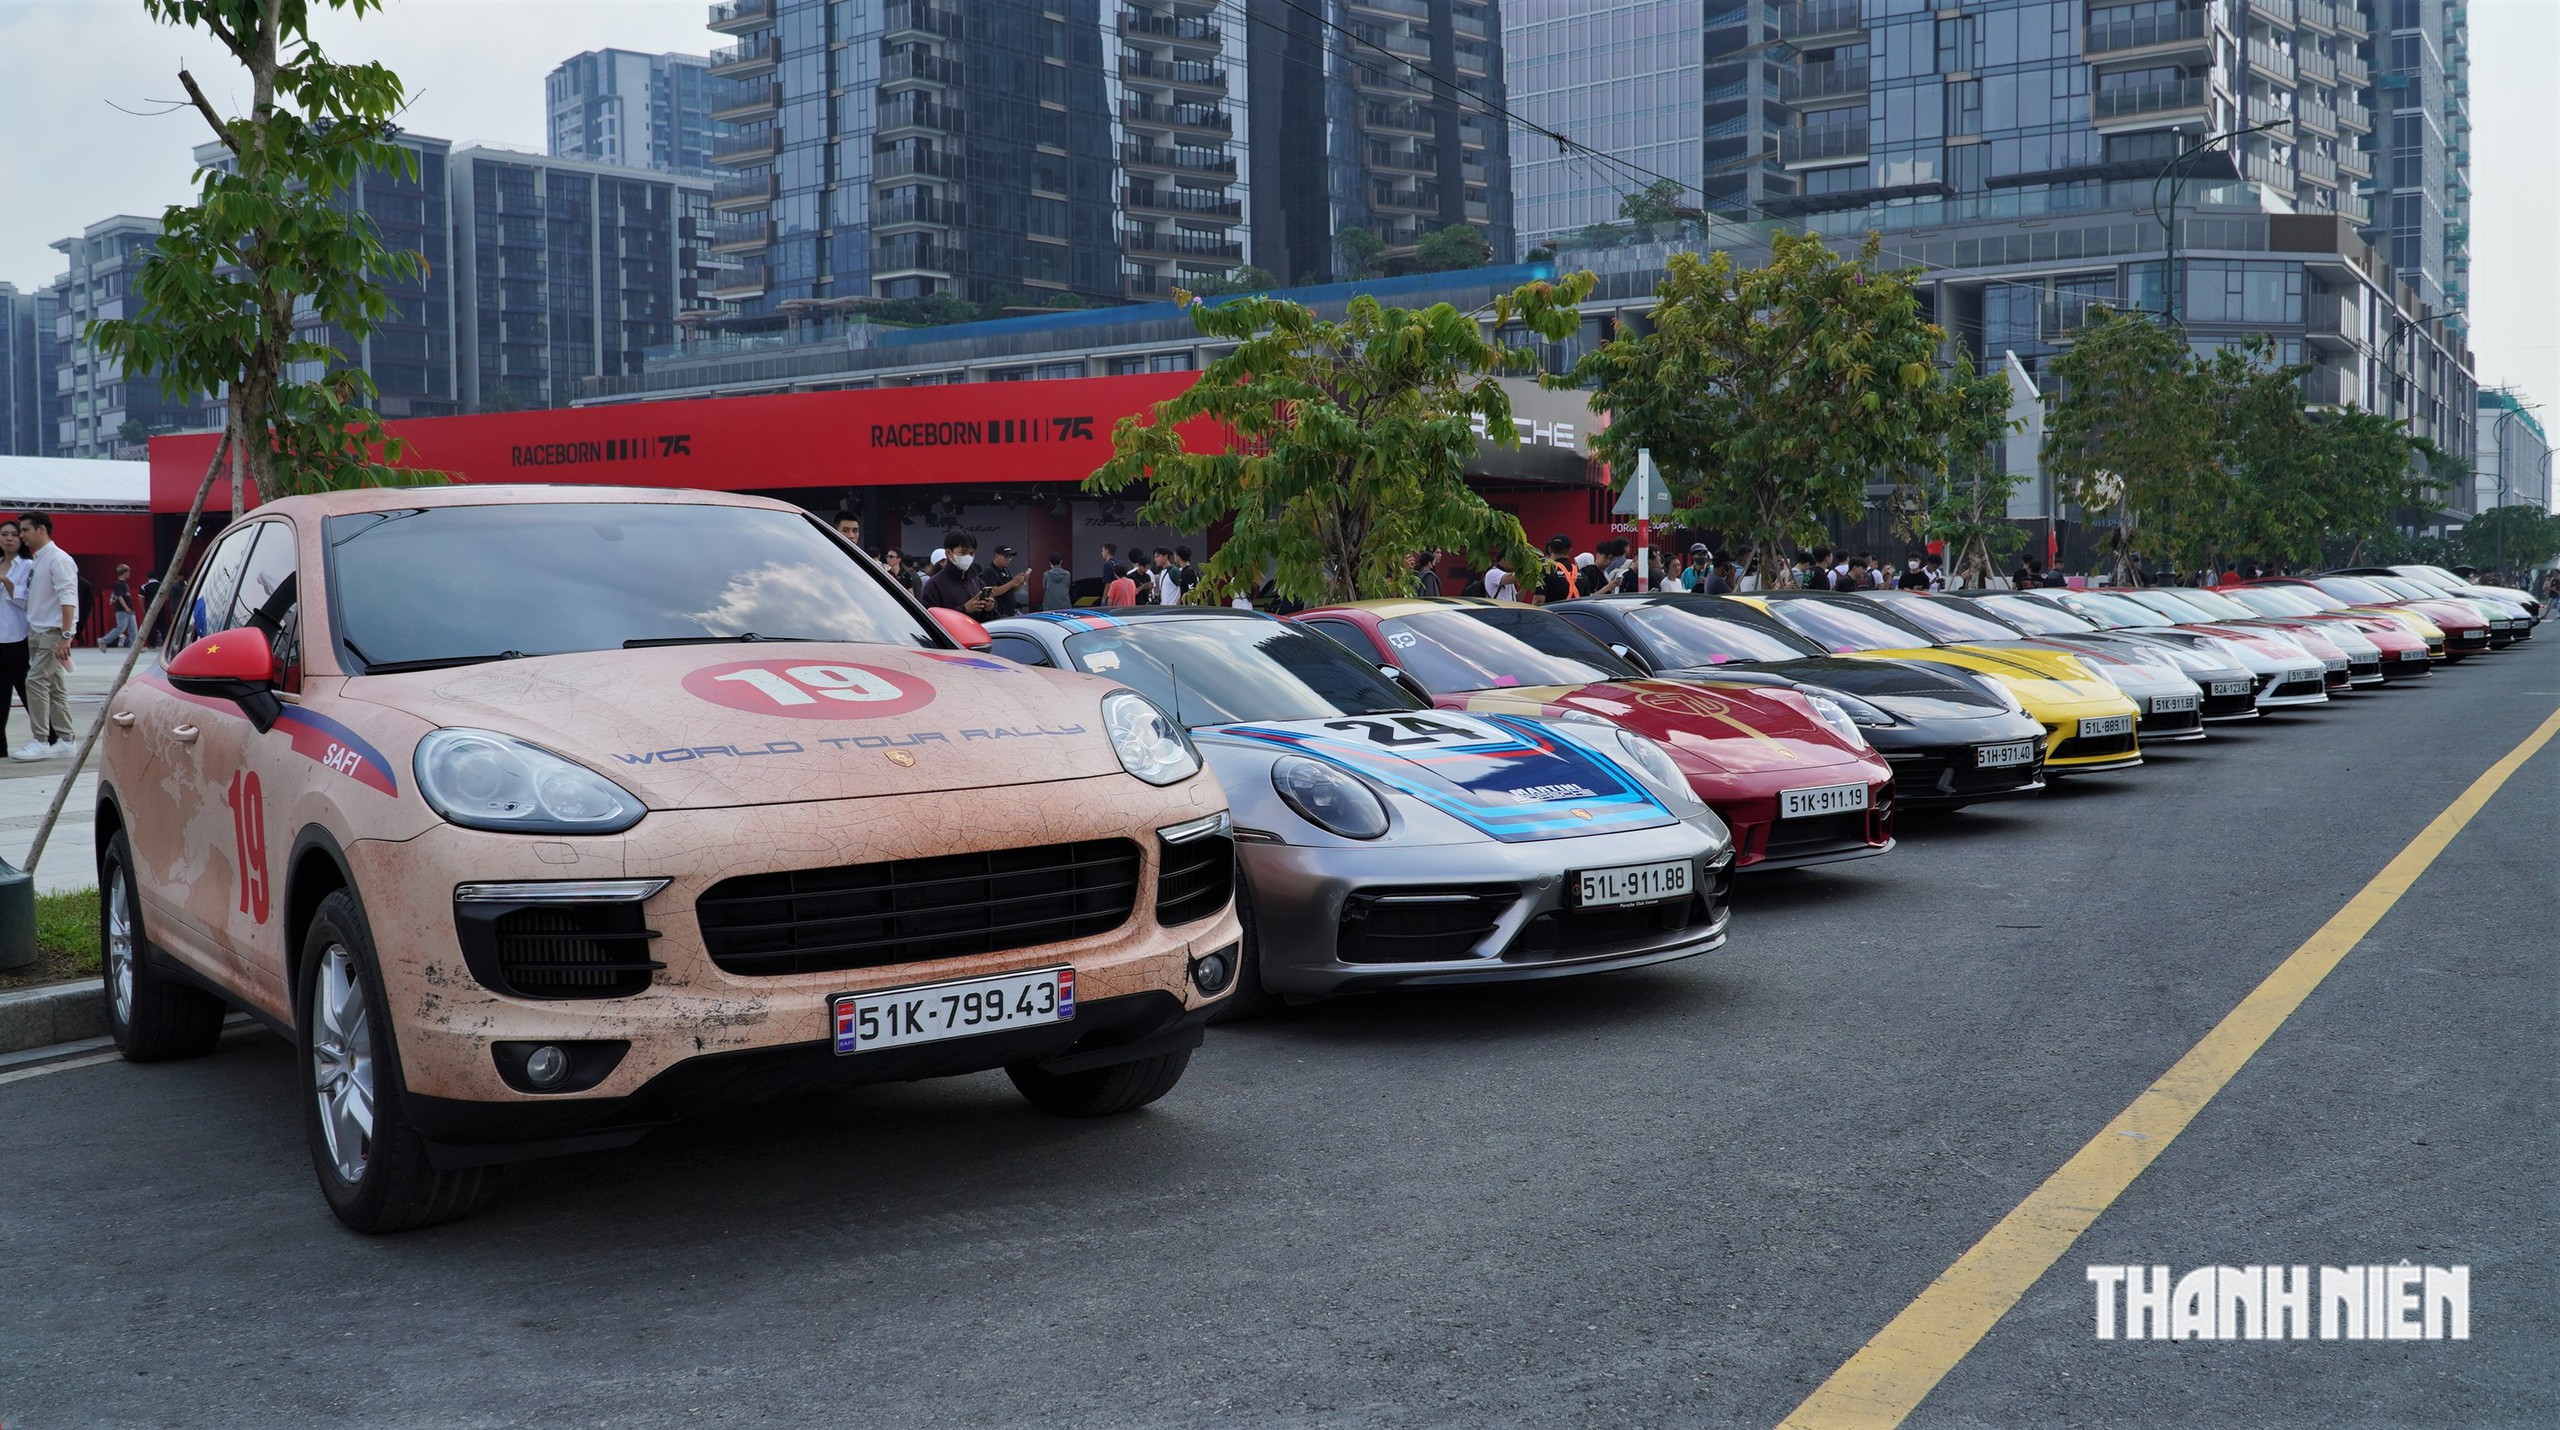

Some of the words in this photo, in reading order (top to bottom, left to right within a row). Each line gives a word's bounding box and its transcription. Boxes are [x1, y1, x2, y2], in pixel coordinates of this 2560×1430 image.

[871, 420, 982, 448] RACEBORN
[1052, 416, 1094, 441] 75
[1458, 411, 1574, 448] RCHE
[512, 441, 601, 467] RACEBORN
[658, 434, 691, 458] 75
[1610, 523, 1652, 533] PORS
[713, 664, 904, 706] 19
[1323, 716, 1488, 747] 24
[2085, 719, 2129, 734] 51L-889.11
[323, 743, 362, 777] SAFI
[611, 740, 803, 766] WORLD
[818, 731, 948, 751] TOUR
[958, 722, 1087, 740] RALLY
[1978, 745, 2031, 764] 51H-971.40
[1508, 783, 1583, 797] MARTINI
[1790, 788, 1862, 813] 51K-911.19
[229, 769, 270, 925] 19
[1583, 866, 1684, 900] 51L-911.88
[859, 981, 1055, 1041] 51K-799.43
